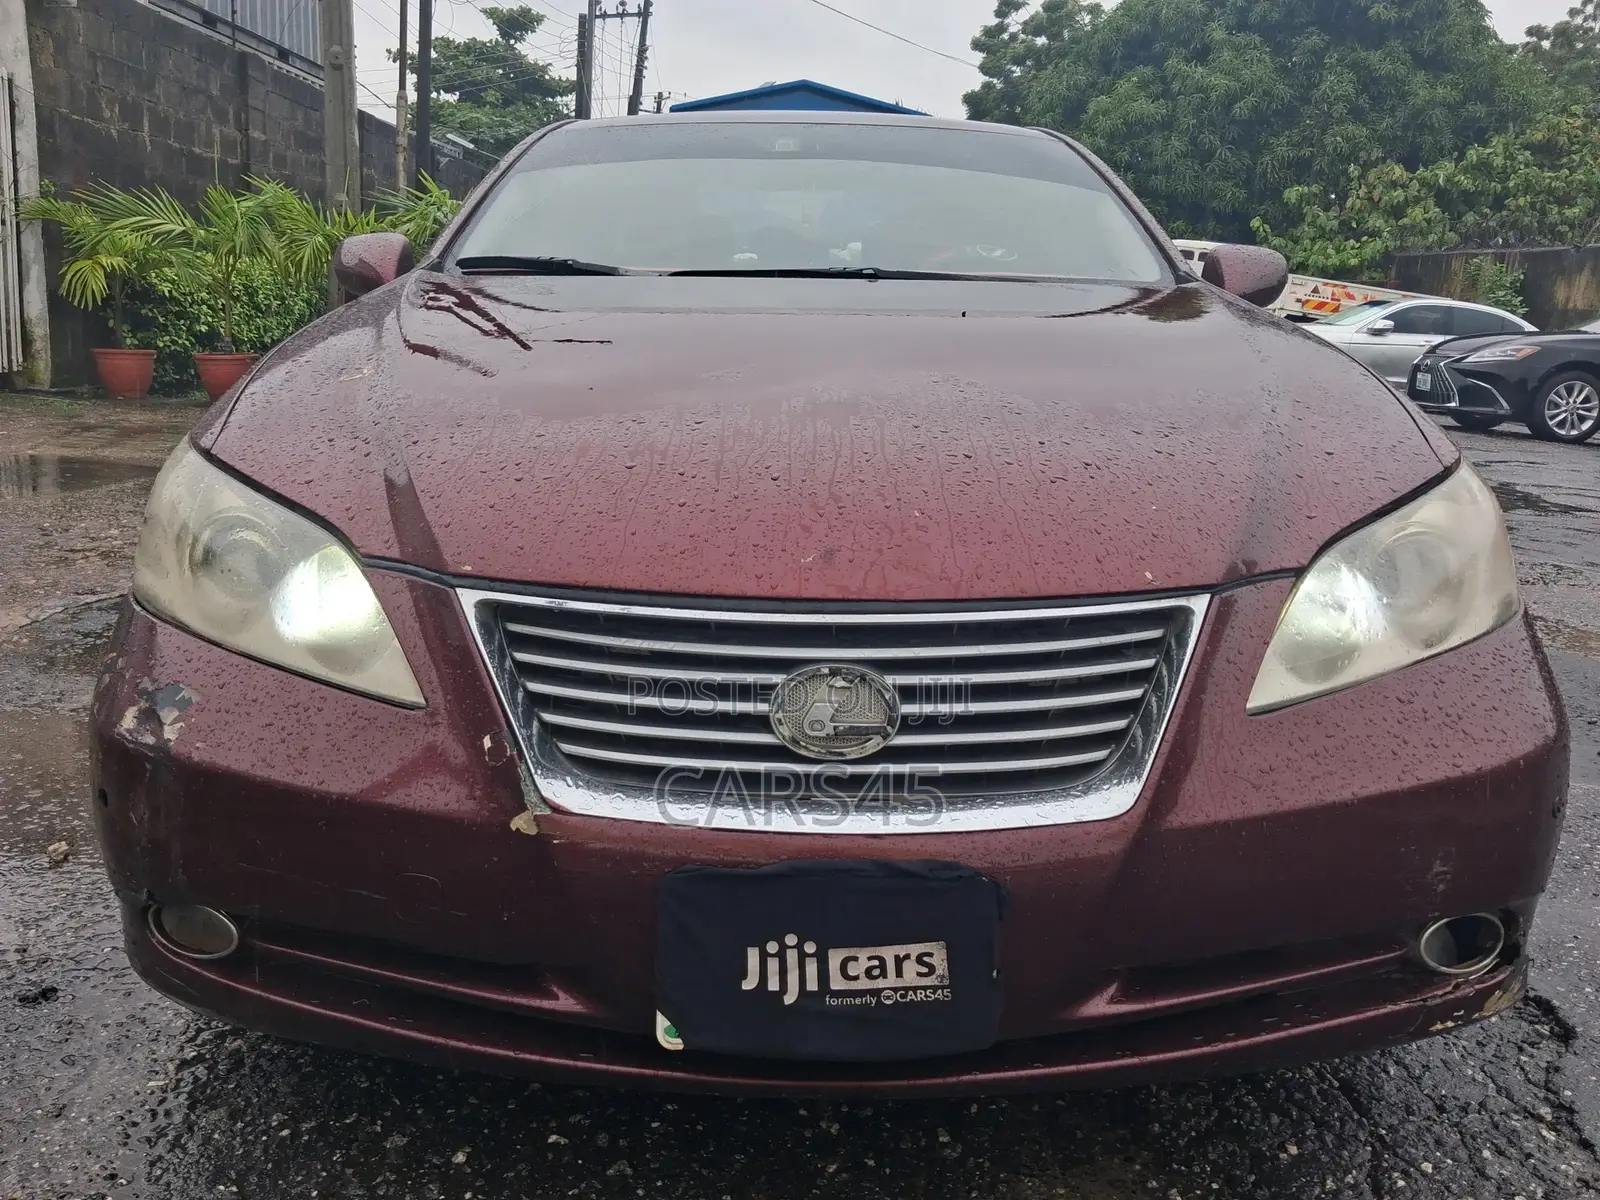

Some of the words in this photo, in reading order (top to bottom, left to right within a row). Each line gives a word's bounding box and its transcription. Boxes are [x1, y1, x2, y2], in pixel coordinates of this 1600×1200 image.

[741, 933, 819, 1005] Jiji
[839, 951, 937, 982] cars
[825, 994, 878, 1007] formerly
[896, 988, 952, 1003] CARS45
